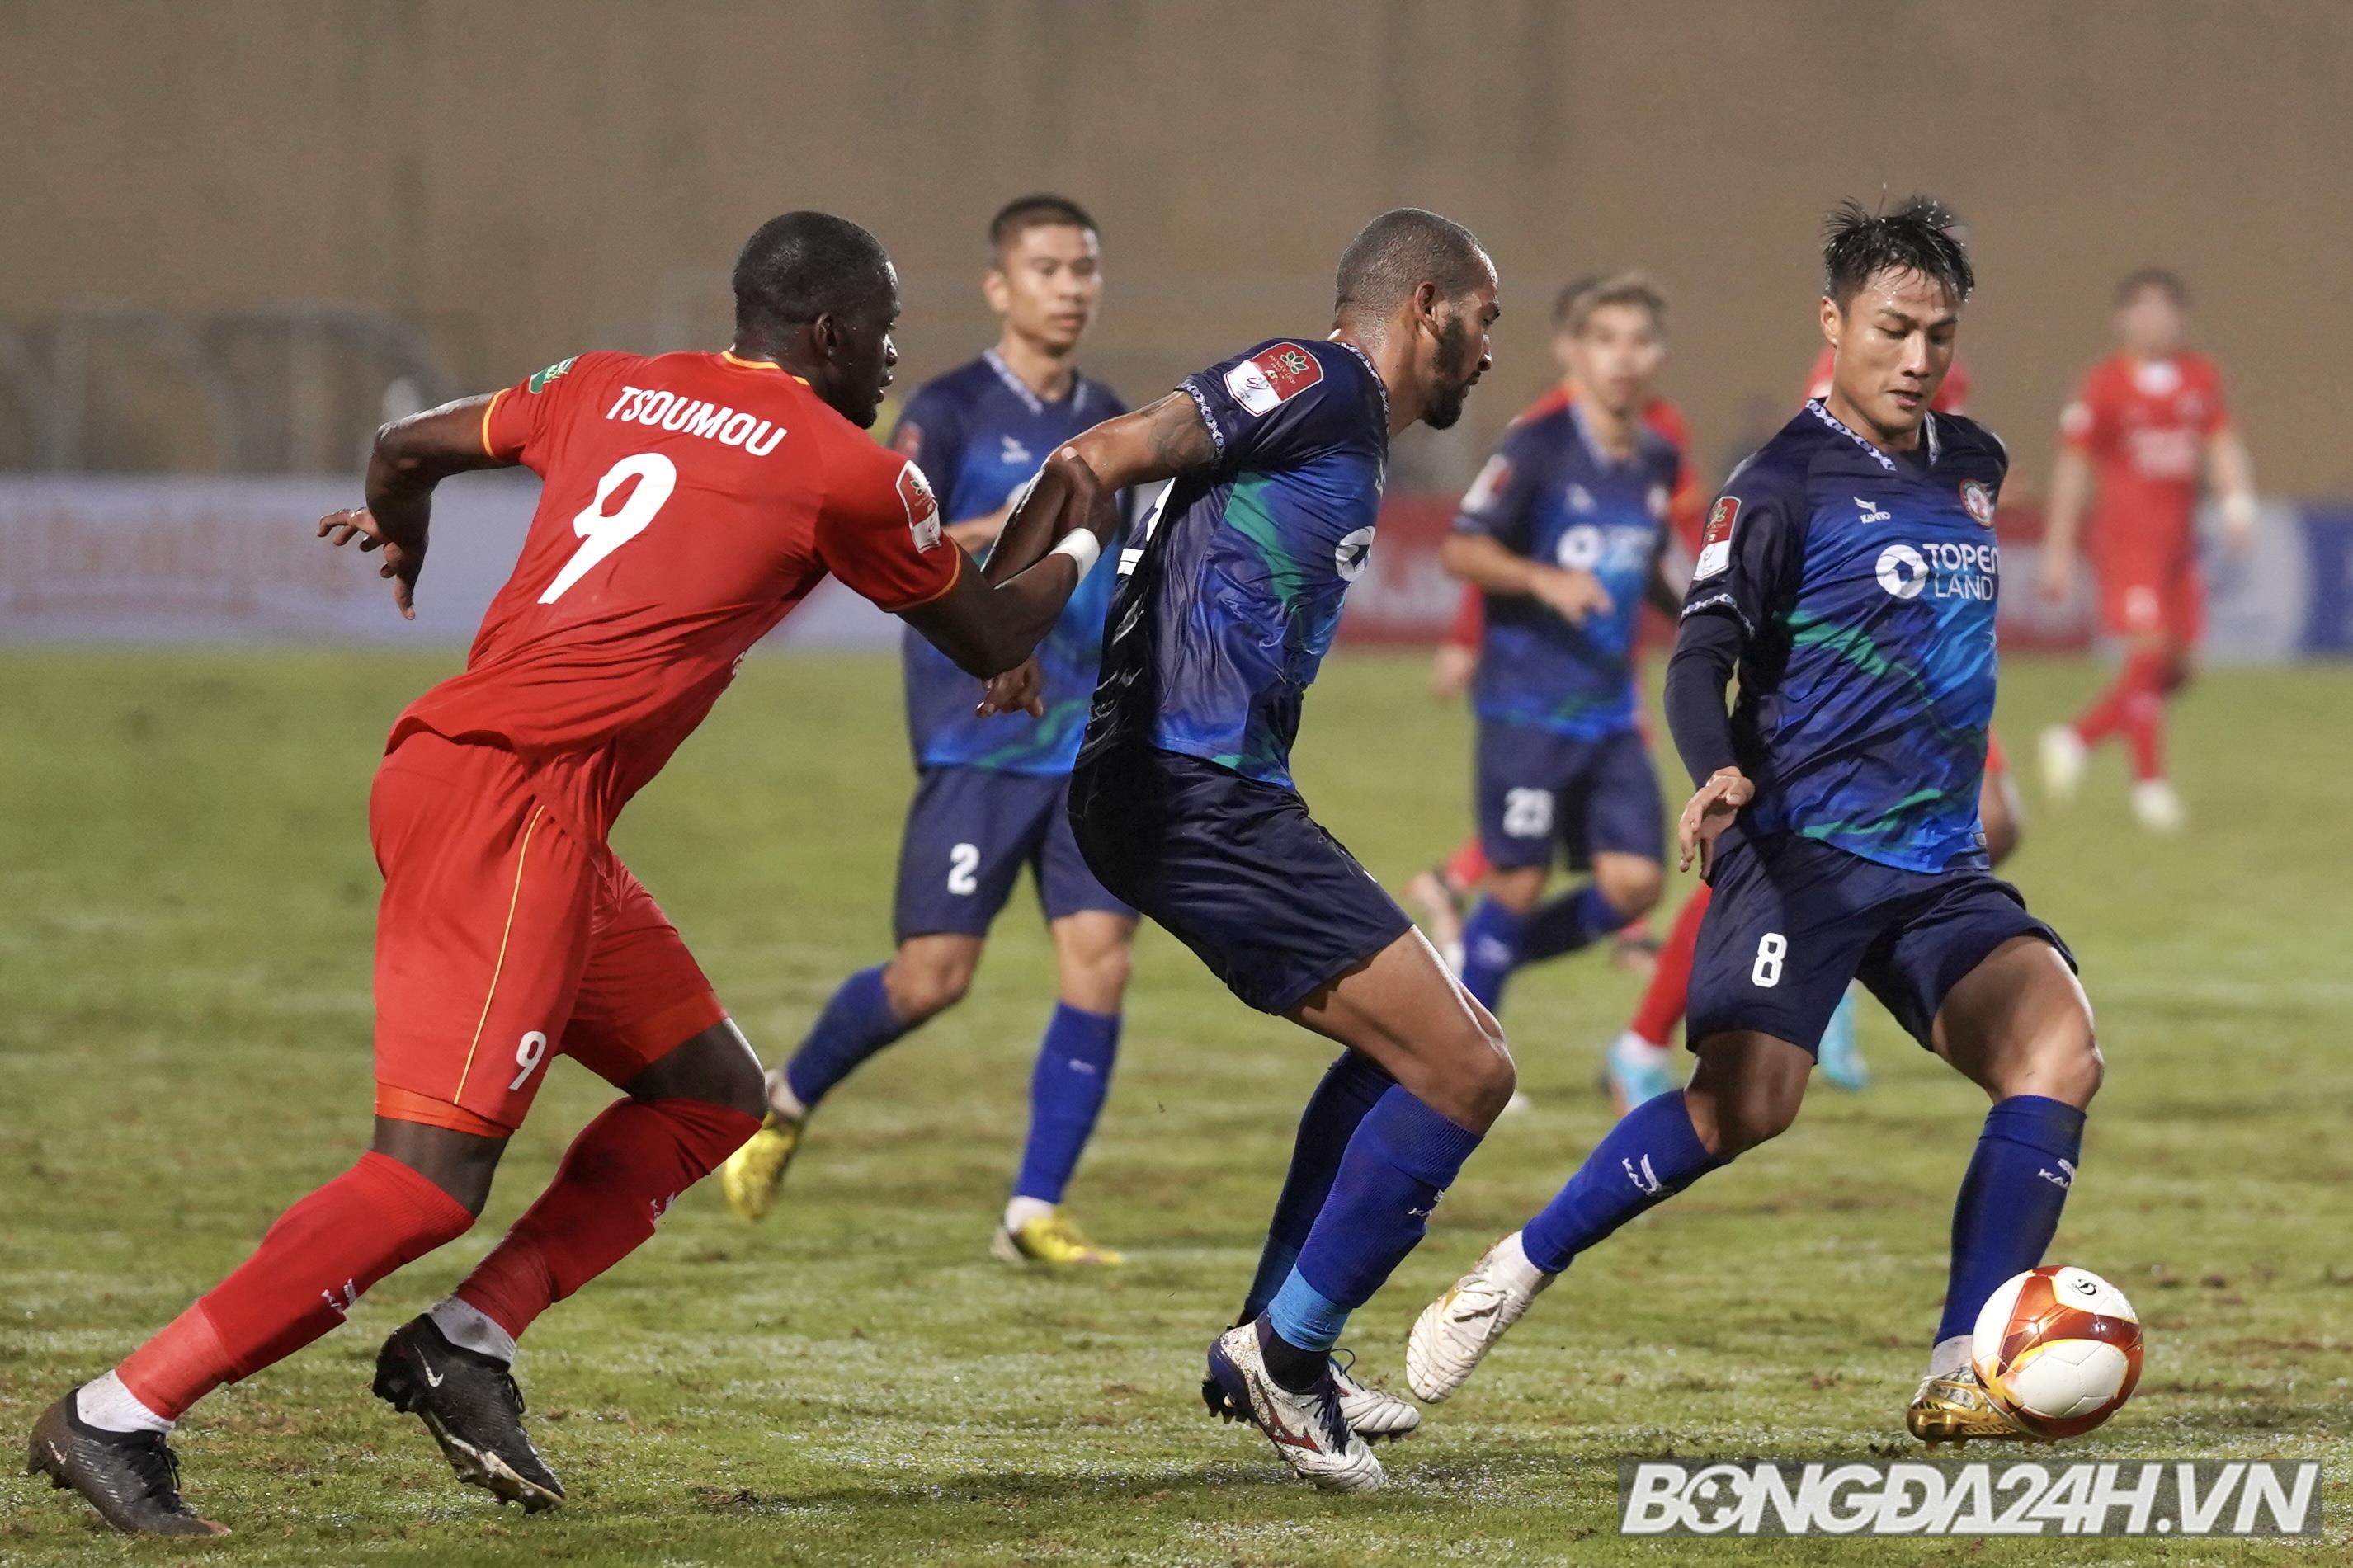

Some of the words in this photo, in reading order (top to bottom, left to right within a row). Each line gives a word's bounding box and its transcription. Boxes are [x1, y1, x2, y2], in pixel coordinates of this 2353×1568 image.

[606, 385, 787, 457] TSOUMOU
[537, 452, 677, 605] 9
[1935, 572, 1993, 601] LAND
[947, 842, 980, 896] 2
[1751, 932, 1788, 988] 8
[509, 1030, 546, 1090] 9
